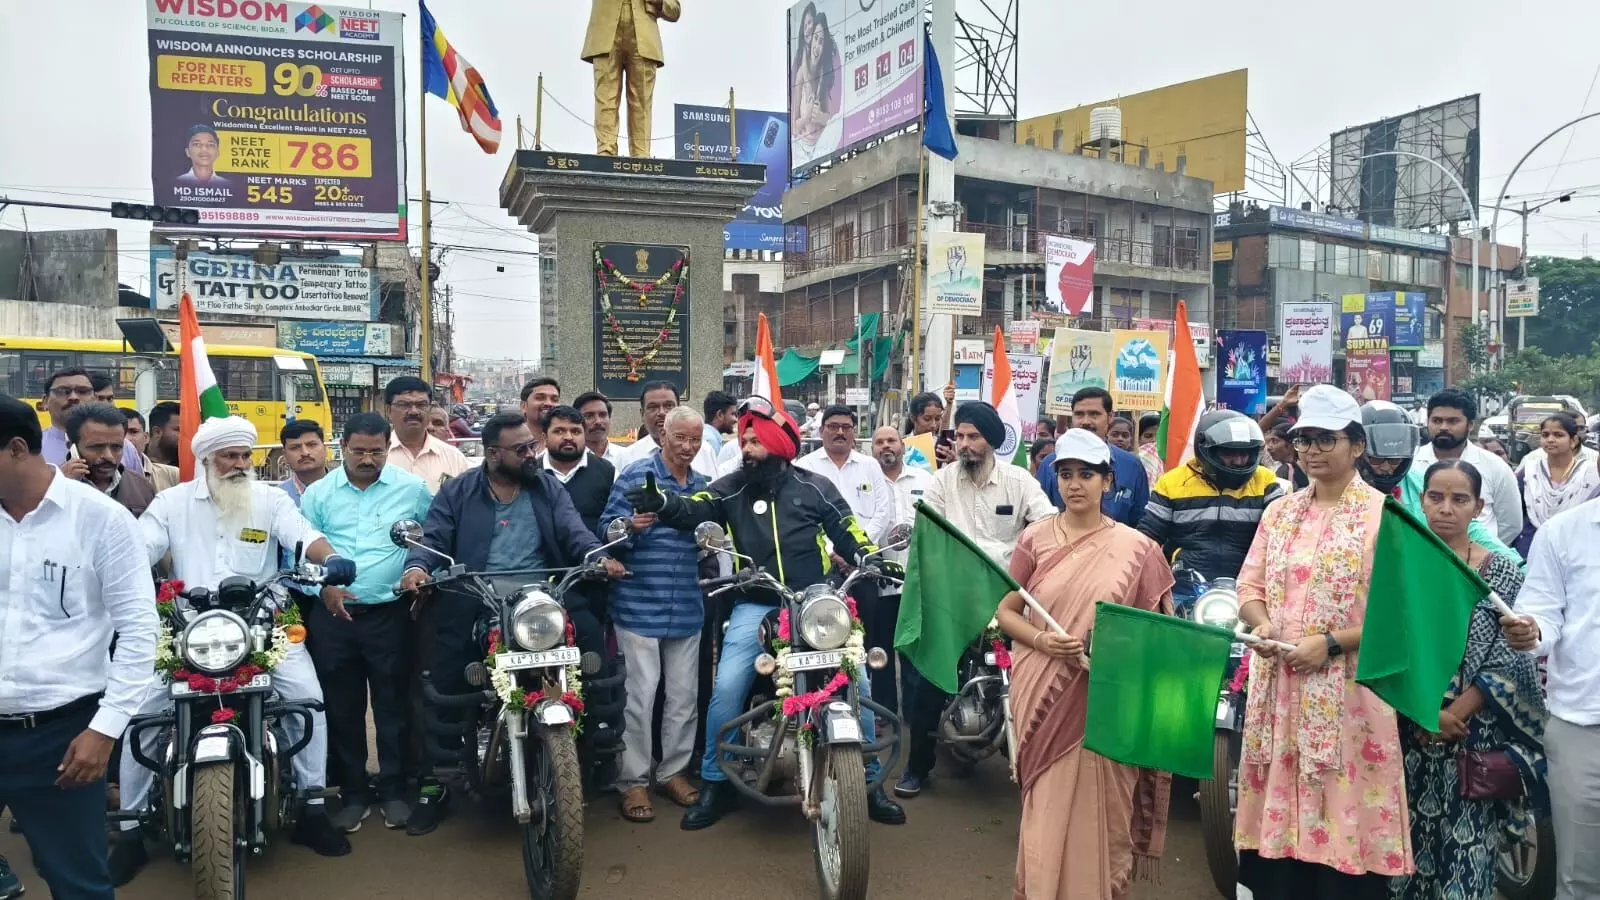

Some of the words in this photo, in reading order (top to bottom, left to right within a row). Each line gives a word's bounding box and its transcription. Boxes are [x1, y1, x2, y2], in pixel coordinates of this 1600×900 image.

[155, 0, 288, 23] WISDOM
[339, 9, 380, 18] WISDOM
[168, 19, 206, 28] COLLEGE
[222, 23, 259, 33] SCIENCE,
[340, 18, 379, 33] NEET
[844, 34, 856, 47] The
[857, 22, 872, 39] Most
[873, 6, 898, 30] Trusted
[899, 0, 916, 15] Care
[343, 32, 376, 40] ACADEMY
[844, 50, 856, 62] For
[856, 37, 879, 56] Women
[886, 16, 915, 39] Children
[156, 39, 213, 53] WISDOM
[214, 43, 296, 59] ANNOUNCES
[297, 49, 383, 64] SCHOLARSHIP
[177, 61, 207, 74] FOR
[209, 63, 246, 76] NEET
[343, 67, 361, 75] UPTO
[855, 69, 867, 90] 13
[876, 58, 889, 76] 14
[900, 45, 913, 65] 04
[171, 72, 253, 88] REPEATERS
[330, 75, 378, 87] SCHOLARSHIP
[330, 86, 356, 95] BASED
[357, 88, 369, 96] ON
[331, 93, 349, 101] NEET
[350, 94, 377, 103] SCORE
[212, 98, 367, 125] Congratulations
[682, 110, 730, 123] SAMSUNG
[213, 121, 258, 130] Wisdomites
[260, 123, 293, 132] Excellent
[294, 125, 317, 133] Result
[230, 136, 266, 147] NEET
[230, 147, 271, 158] STATE
[683, 142, 715, 155] Gaaxy
[715, 144, 728, 153] A17
[287, 140, 360, 171] 786
[231, 157, 270, 169] RANK
[547, 155, 580, 170] ಶಿಕ್ಷಣ
[247, 176, 273, 185] NEET
[274, 177, 307, 187] MARKS
[173, 187, 191, 196] MD
[194, 187, 233, 197] ISMAIL
[247, 185, 293, 205] 545
[341, 194, 364, 202] GOVT
[199, 211, 260, 221] 951598889
[189, 258, 299, 281] GEHNA
[344, 268, 368, 278] Tattoo
[193, 280, 300, 300] TATTOO
[344, 280, 368, 289] Tattoo
[223, 301, 243, 310] Fathe
[244, 302, 263, 313] Singh
[1369, 318, 1383, 335] 69
[1346, 338, 1388, 349] SUPRIYA
[511, 655, 522, 665] KA
[529, 653, 539, 664] 38
[799, 656, 810, 666] KA
[816, 654, 827, 664] 38
